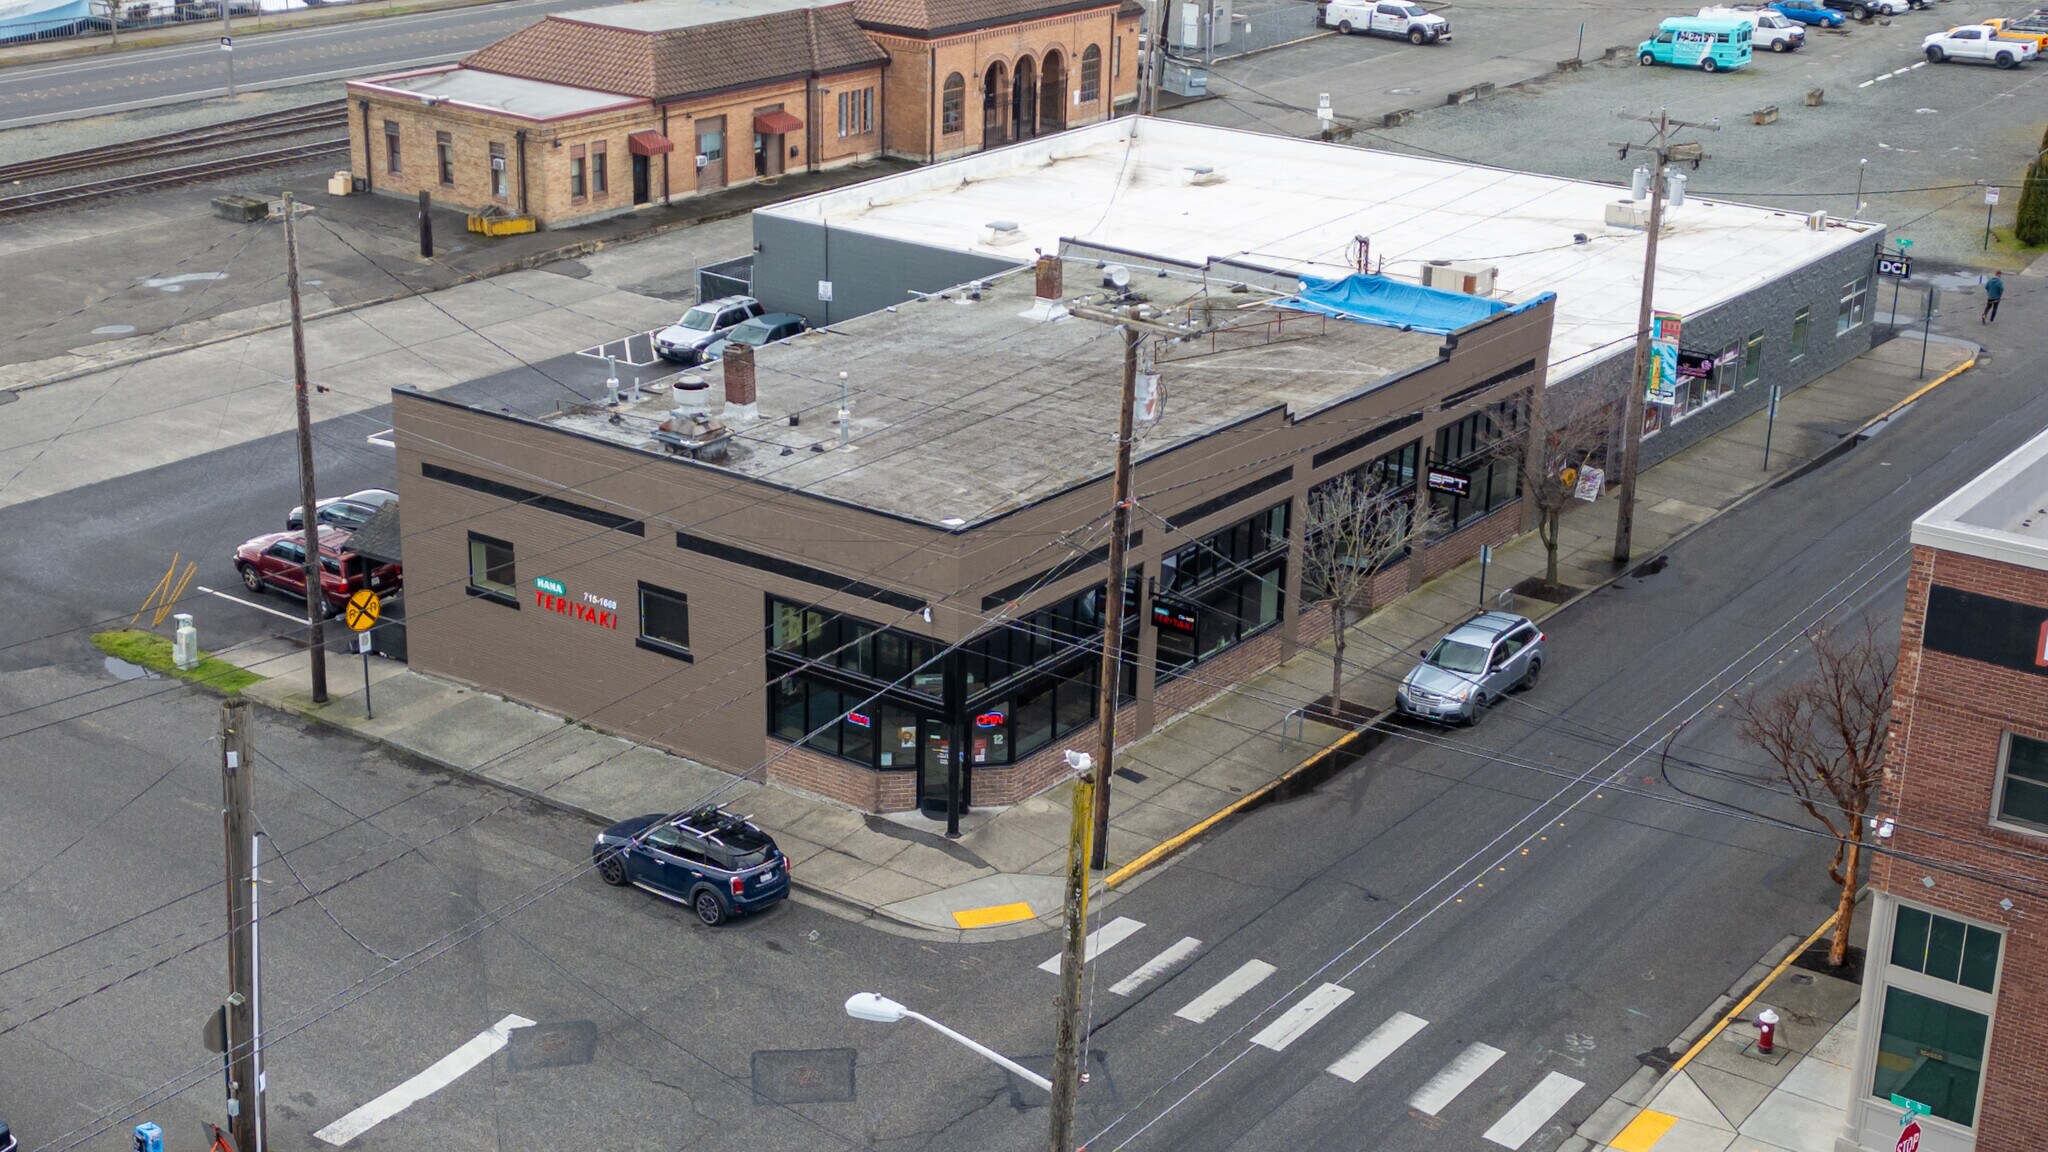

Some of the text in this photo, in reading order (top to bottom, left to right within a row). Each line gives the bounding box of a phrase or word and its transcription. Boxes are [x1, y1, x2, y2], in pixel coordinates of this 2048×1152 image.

[537, 578, 562, 594] HANA
[349, 601, 377, 620] R R
[535, 590, 617, 630] TERIYAKI
[976, 714, 1003, 725] OPEN
[993, 734, 1004, 745] 12
[1897, 1132, 1920, 1152] STOP
